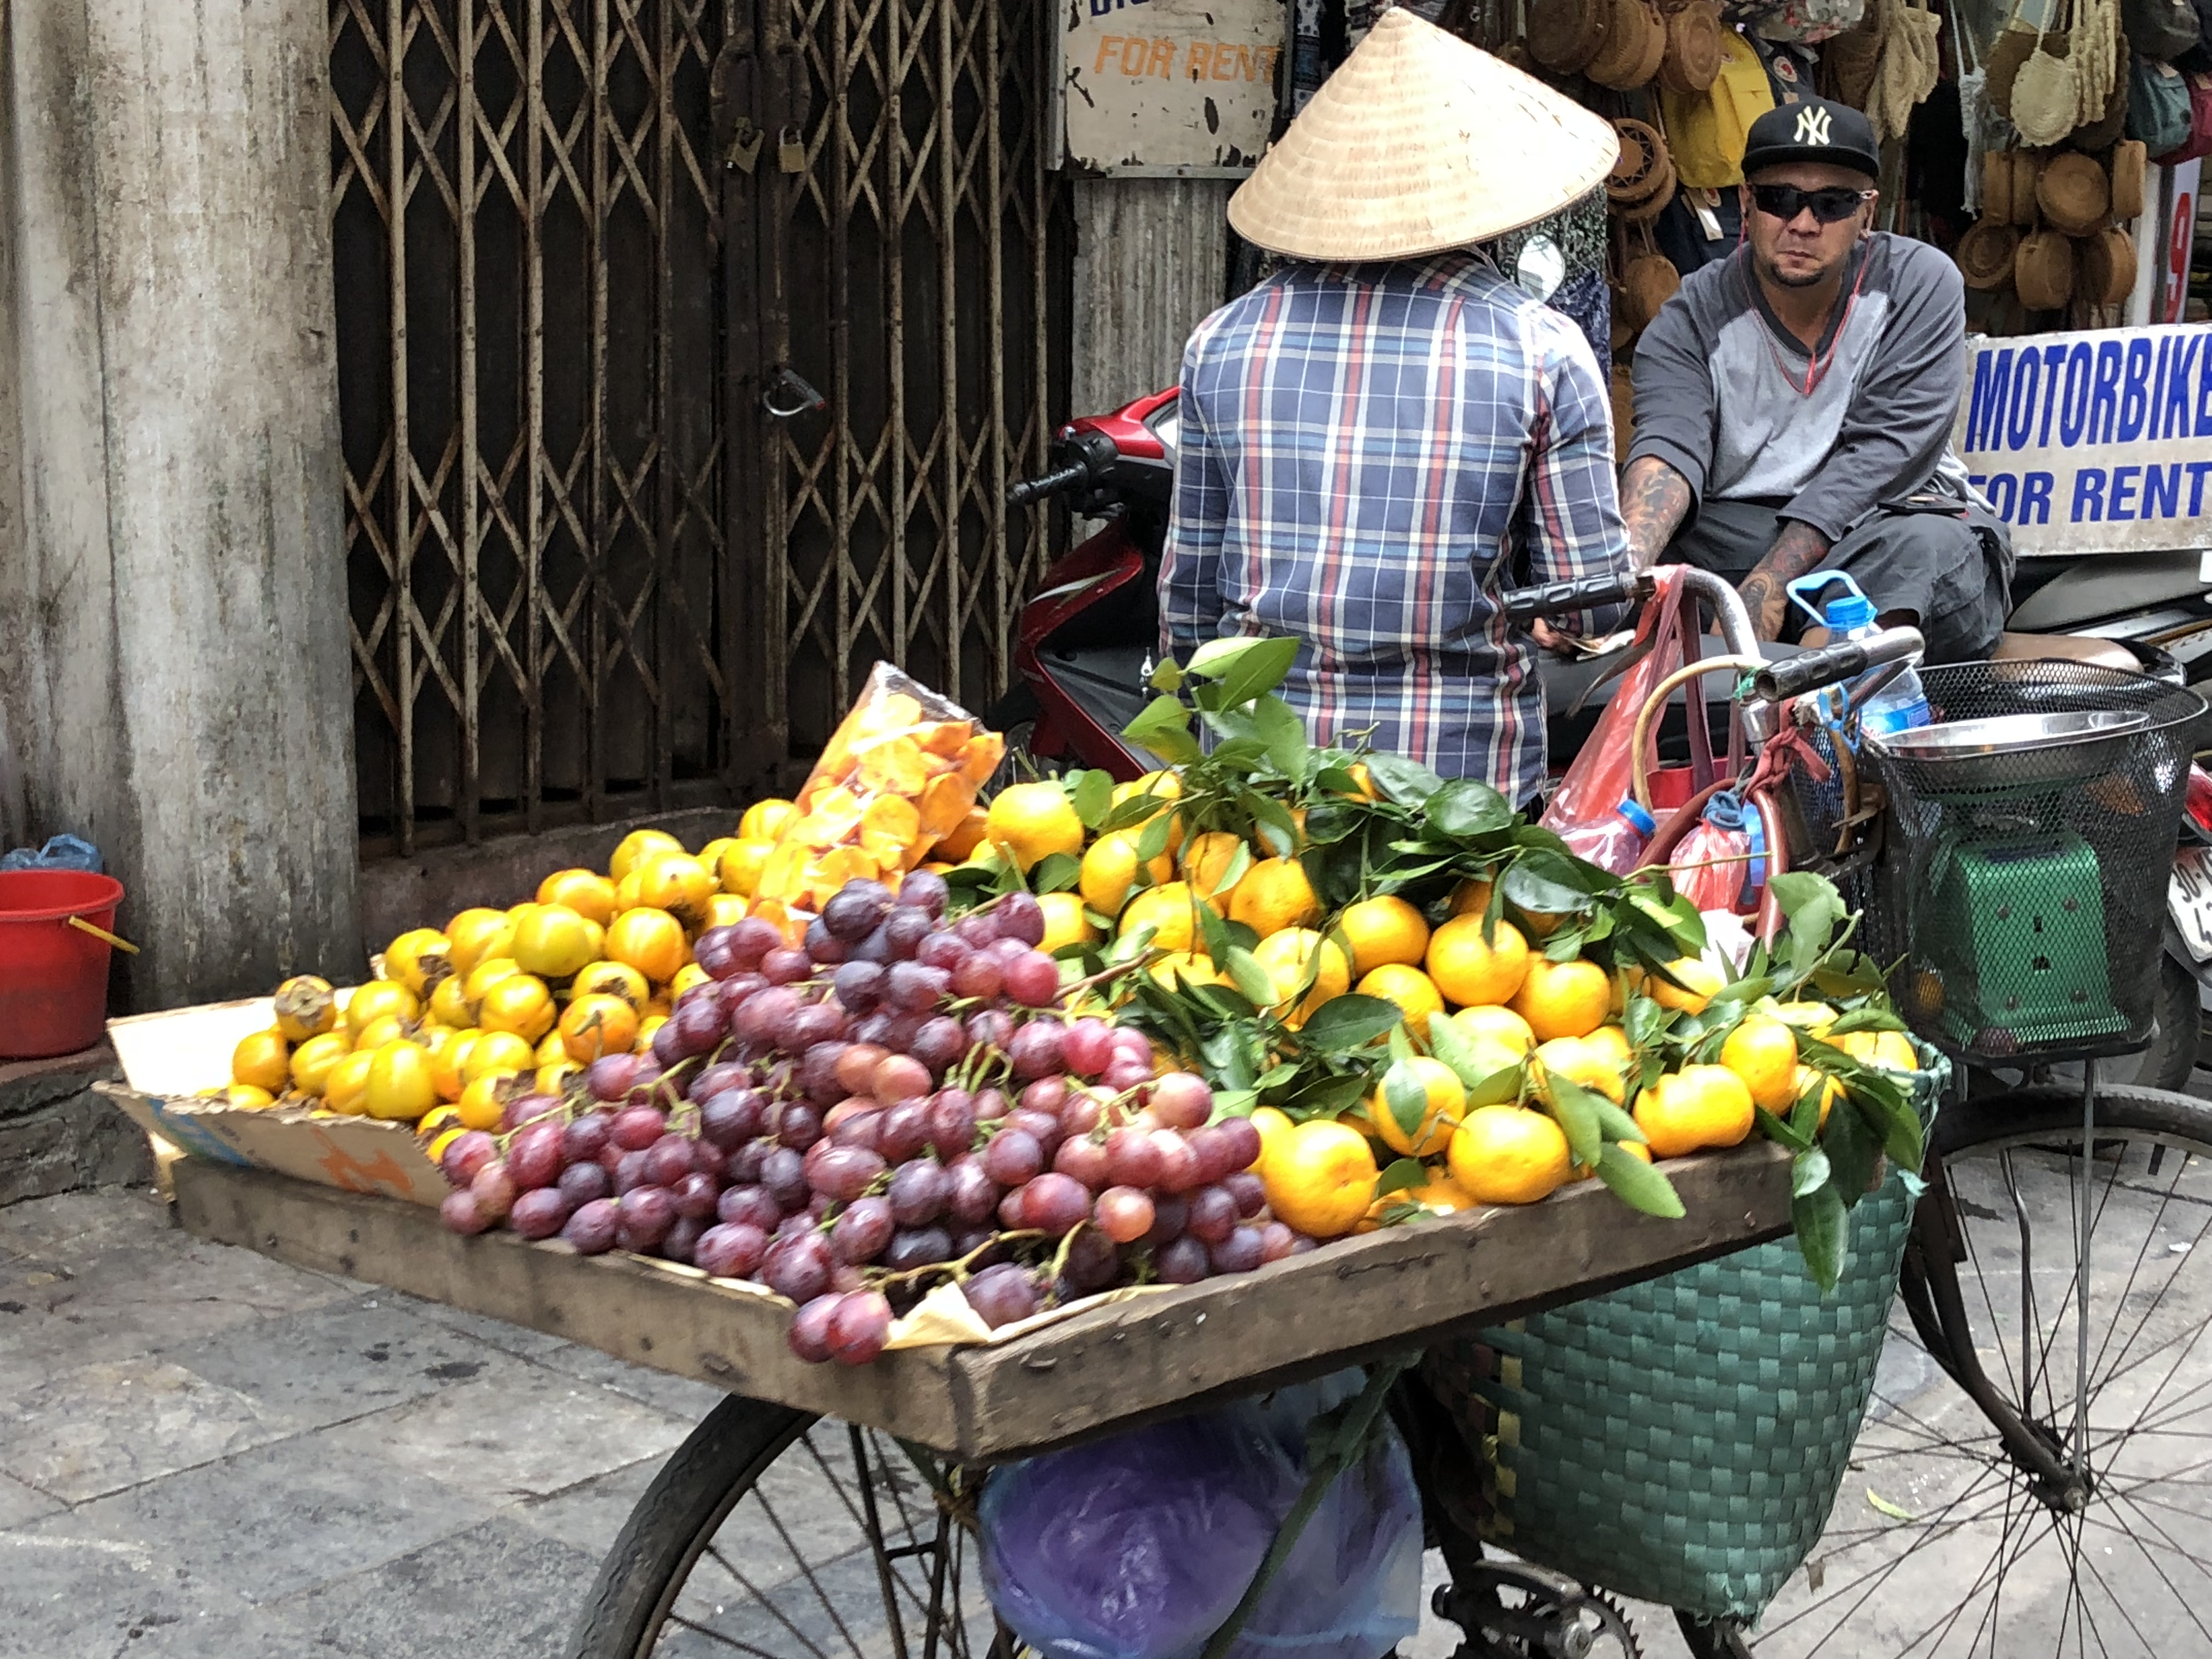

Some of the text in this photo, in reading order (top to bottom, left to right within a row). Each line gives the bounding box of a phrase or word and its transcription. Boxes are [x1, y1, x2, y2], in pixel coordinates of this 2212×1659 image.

[1094, 36, 1282, 83] FOR RENT
[1793, 105, 1832, 146] NY
[1968, 462, 2212, 525] OR RENT
